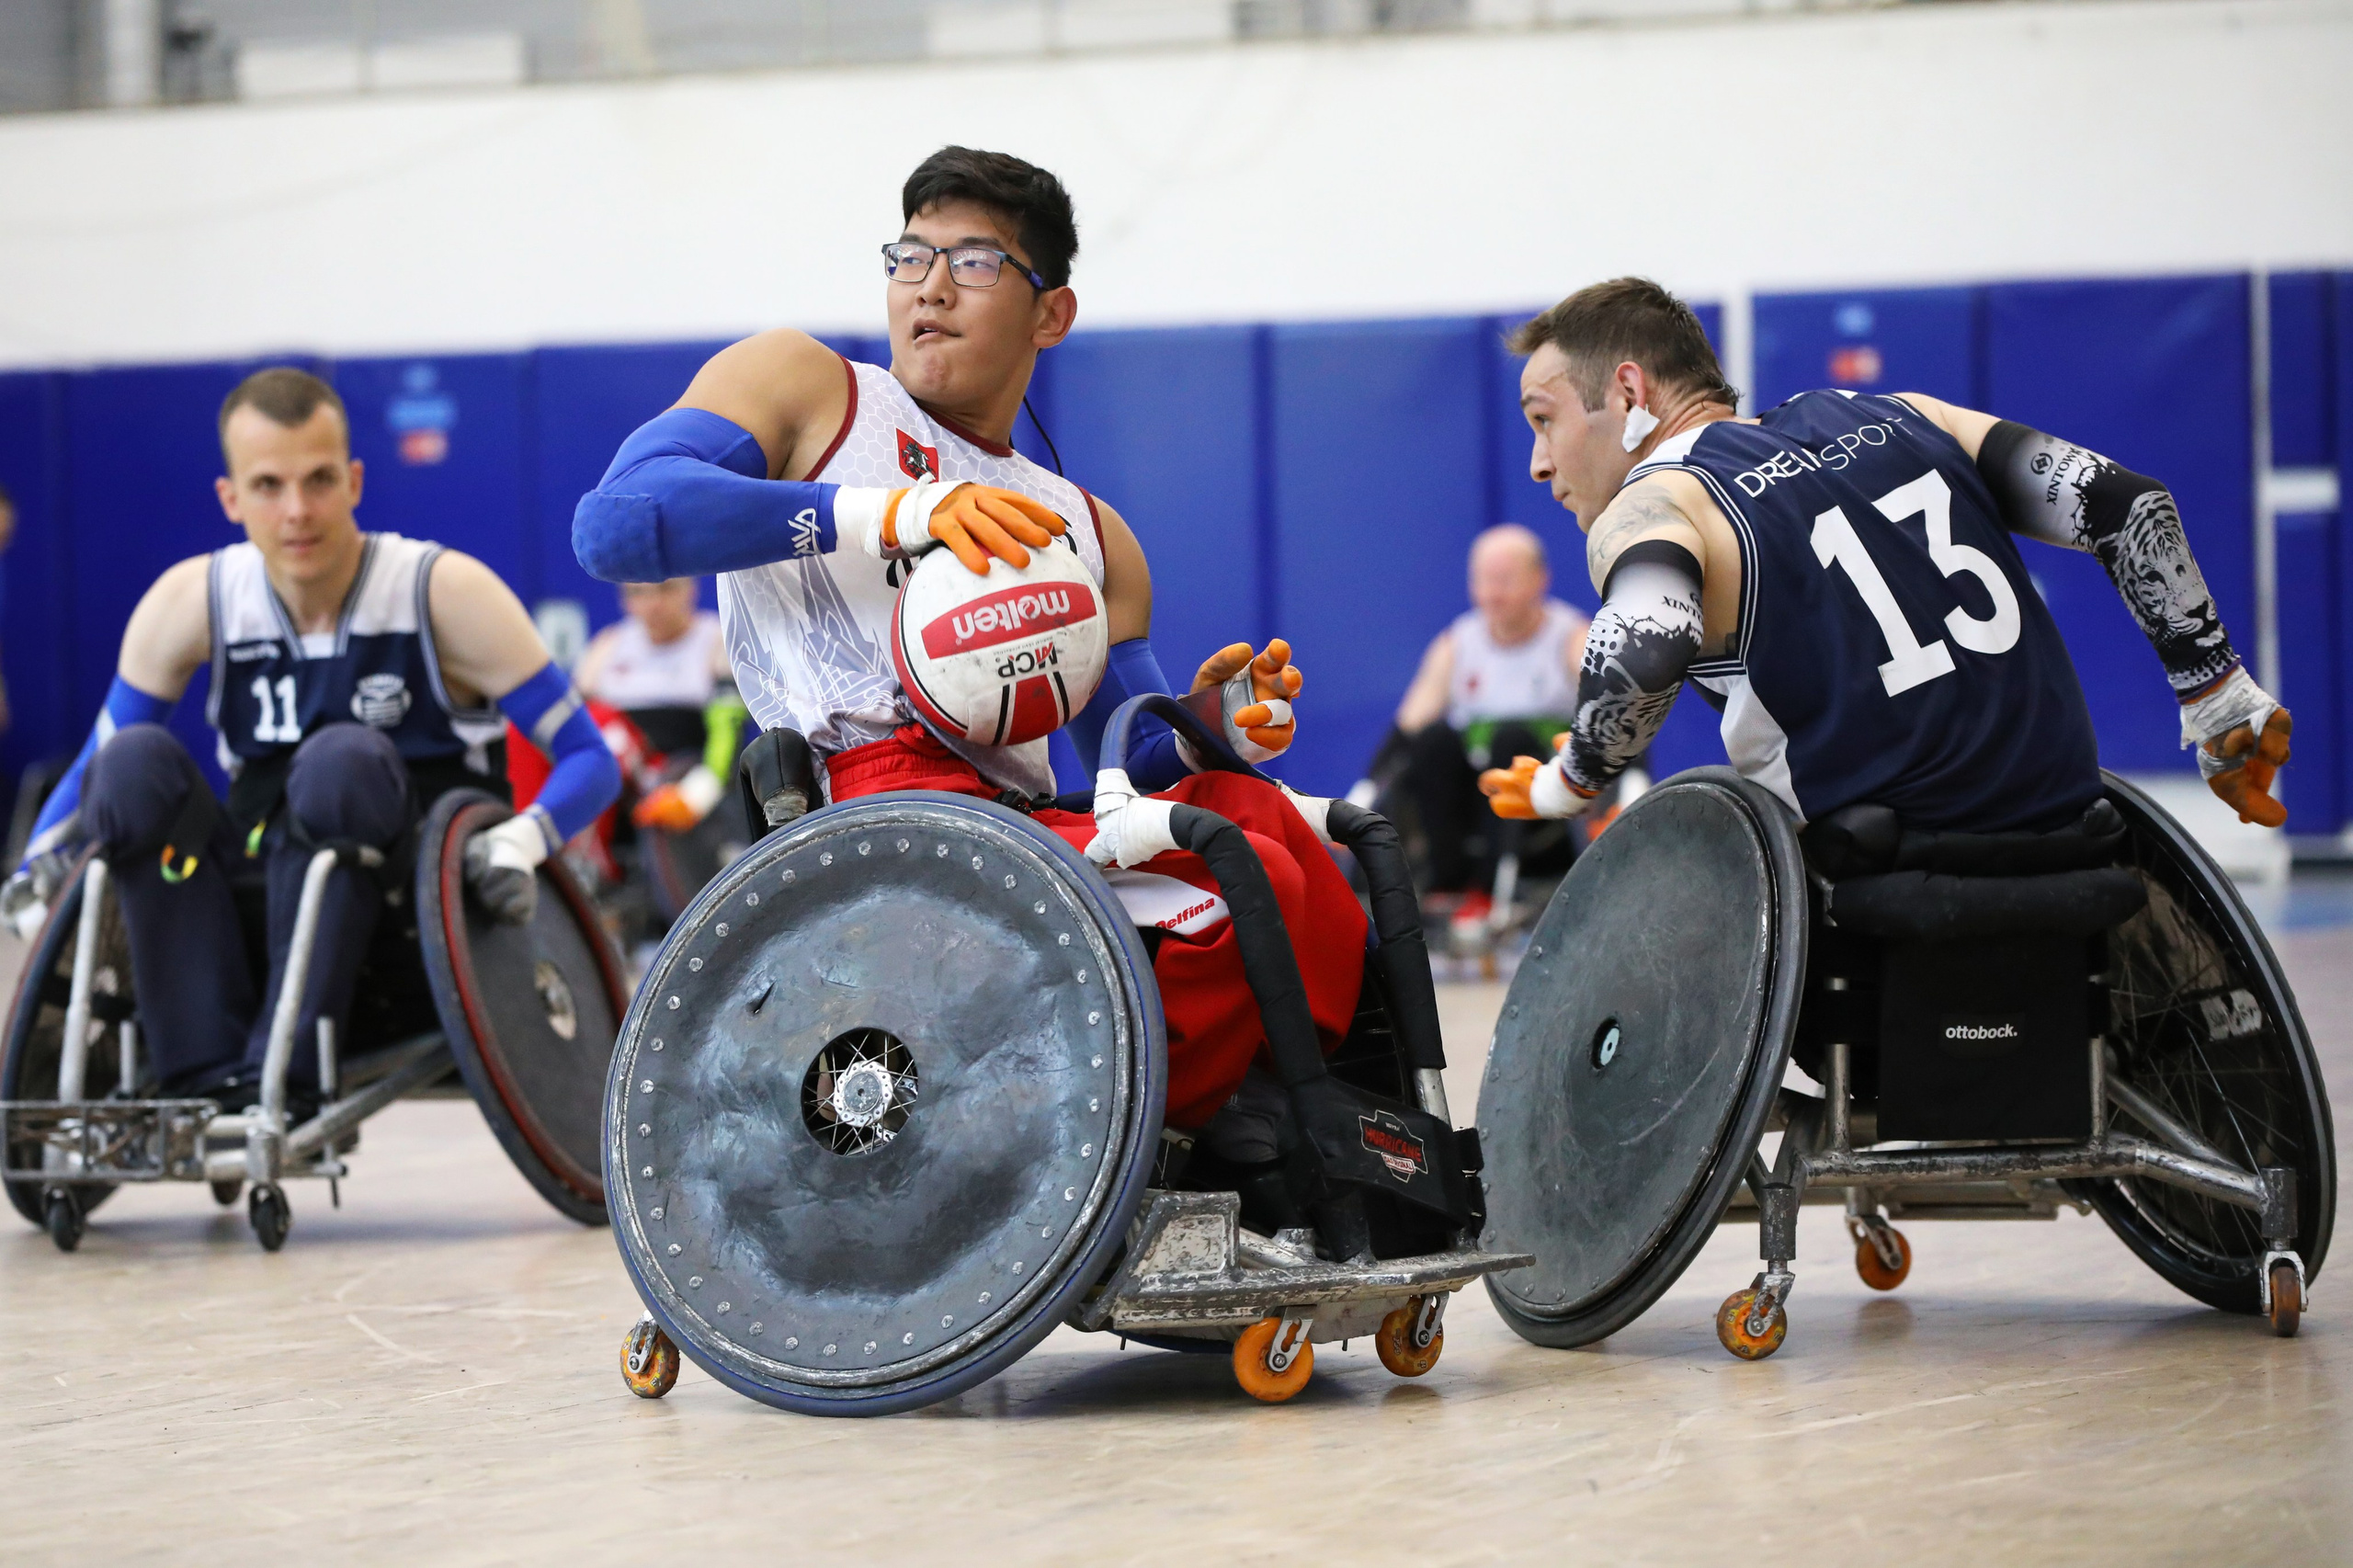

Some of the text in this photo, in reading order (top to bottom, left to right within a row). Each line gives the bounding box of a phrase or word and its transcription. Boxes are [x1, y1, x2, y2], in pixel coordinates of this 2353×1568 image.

[1809, 468, 2022, 699] 13
[951, 589, 1071, 640] molten
[997, 641, 1058, 678] MCP
[250, 674, 303, 743] 11
[1945, 1023, 2018, 1040] ottobock.
